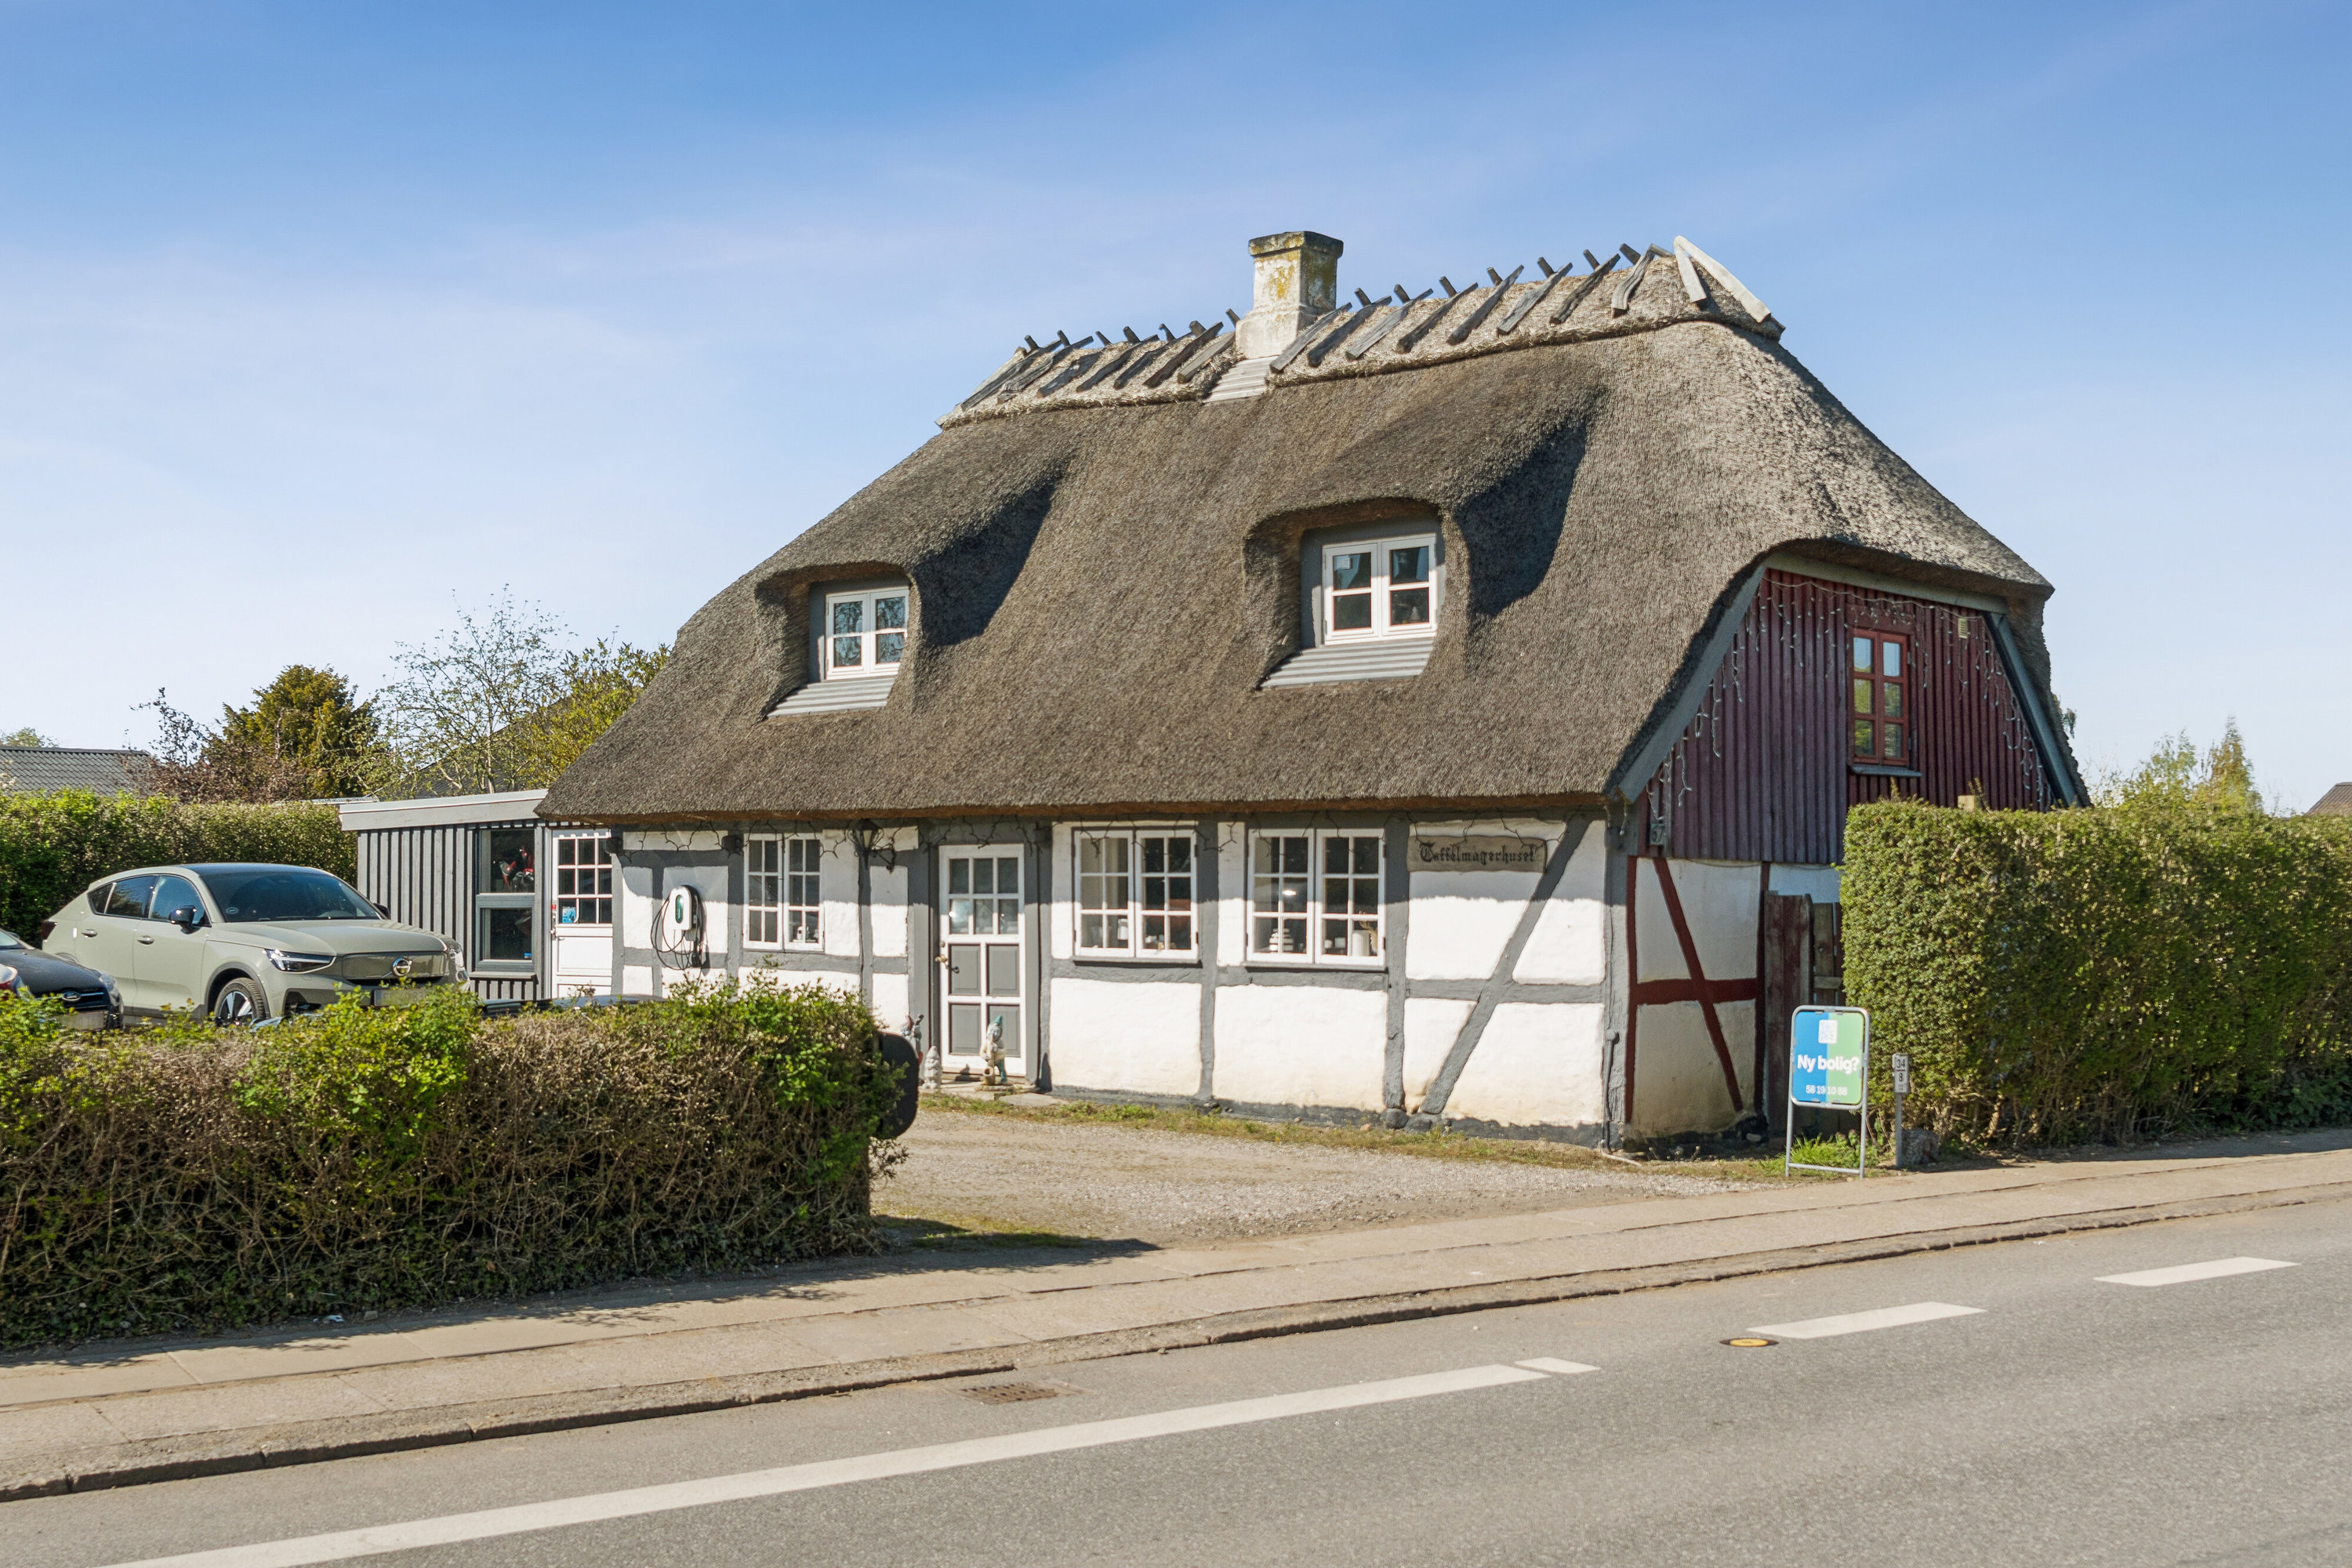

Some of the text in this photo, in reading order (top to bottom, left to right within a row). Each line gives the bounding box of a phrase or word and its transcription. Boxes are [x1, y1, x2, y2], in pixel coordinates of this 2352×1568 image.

[1797, 1054, 1860, 1076] Ny bolig?
[1828, 1086, 1836, 1095] 10
